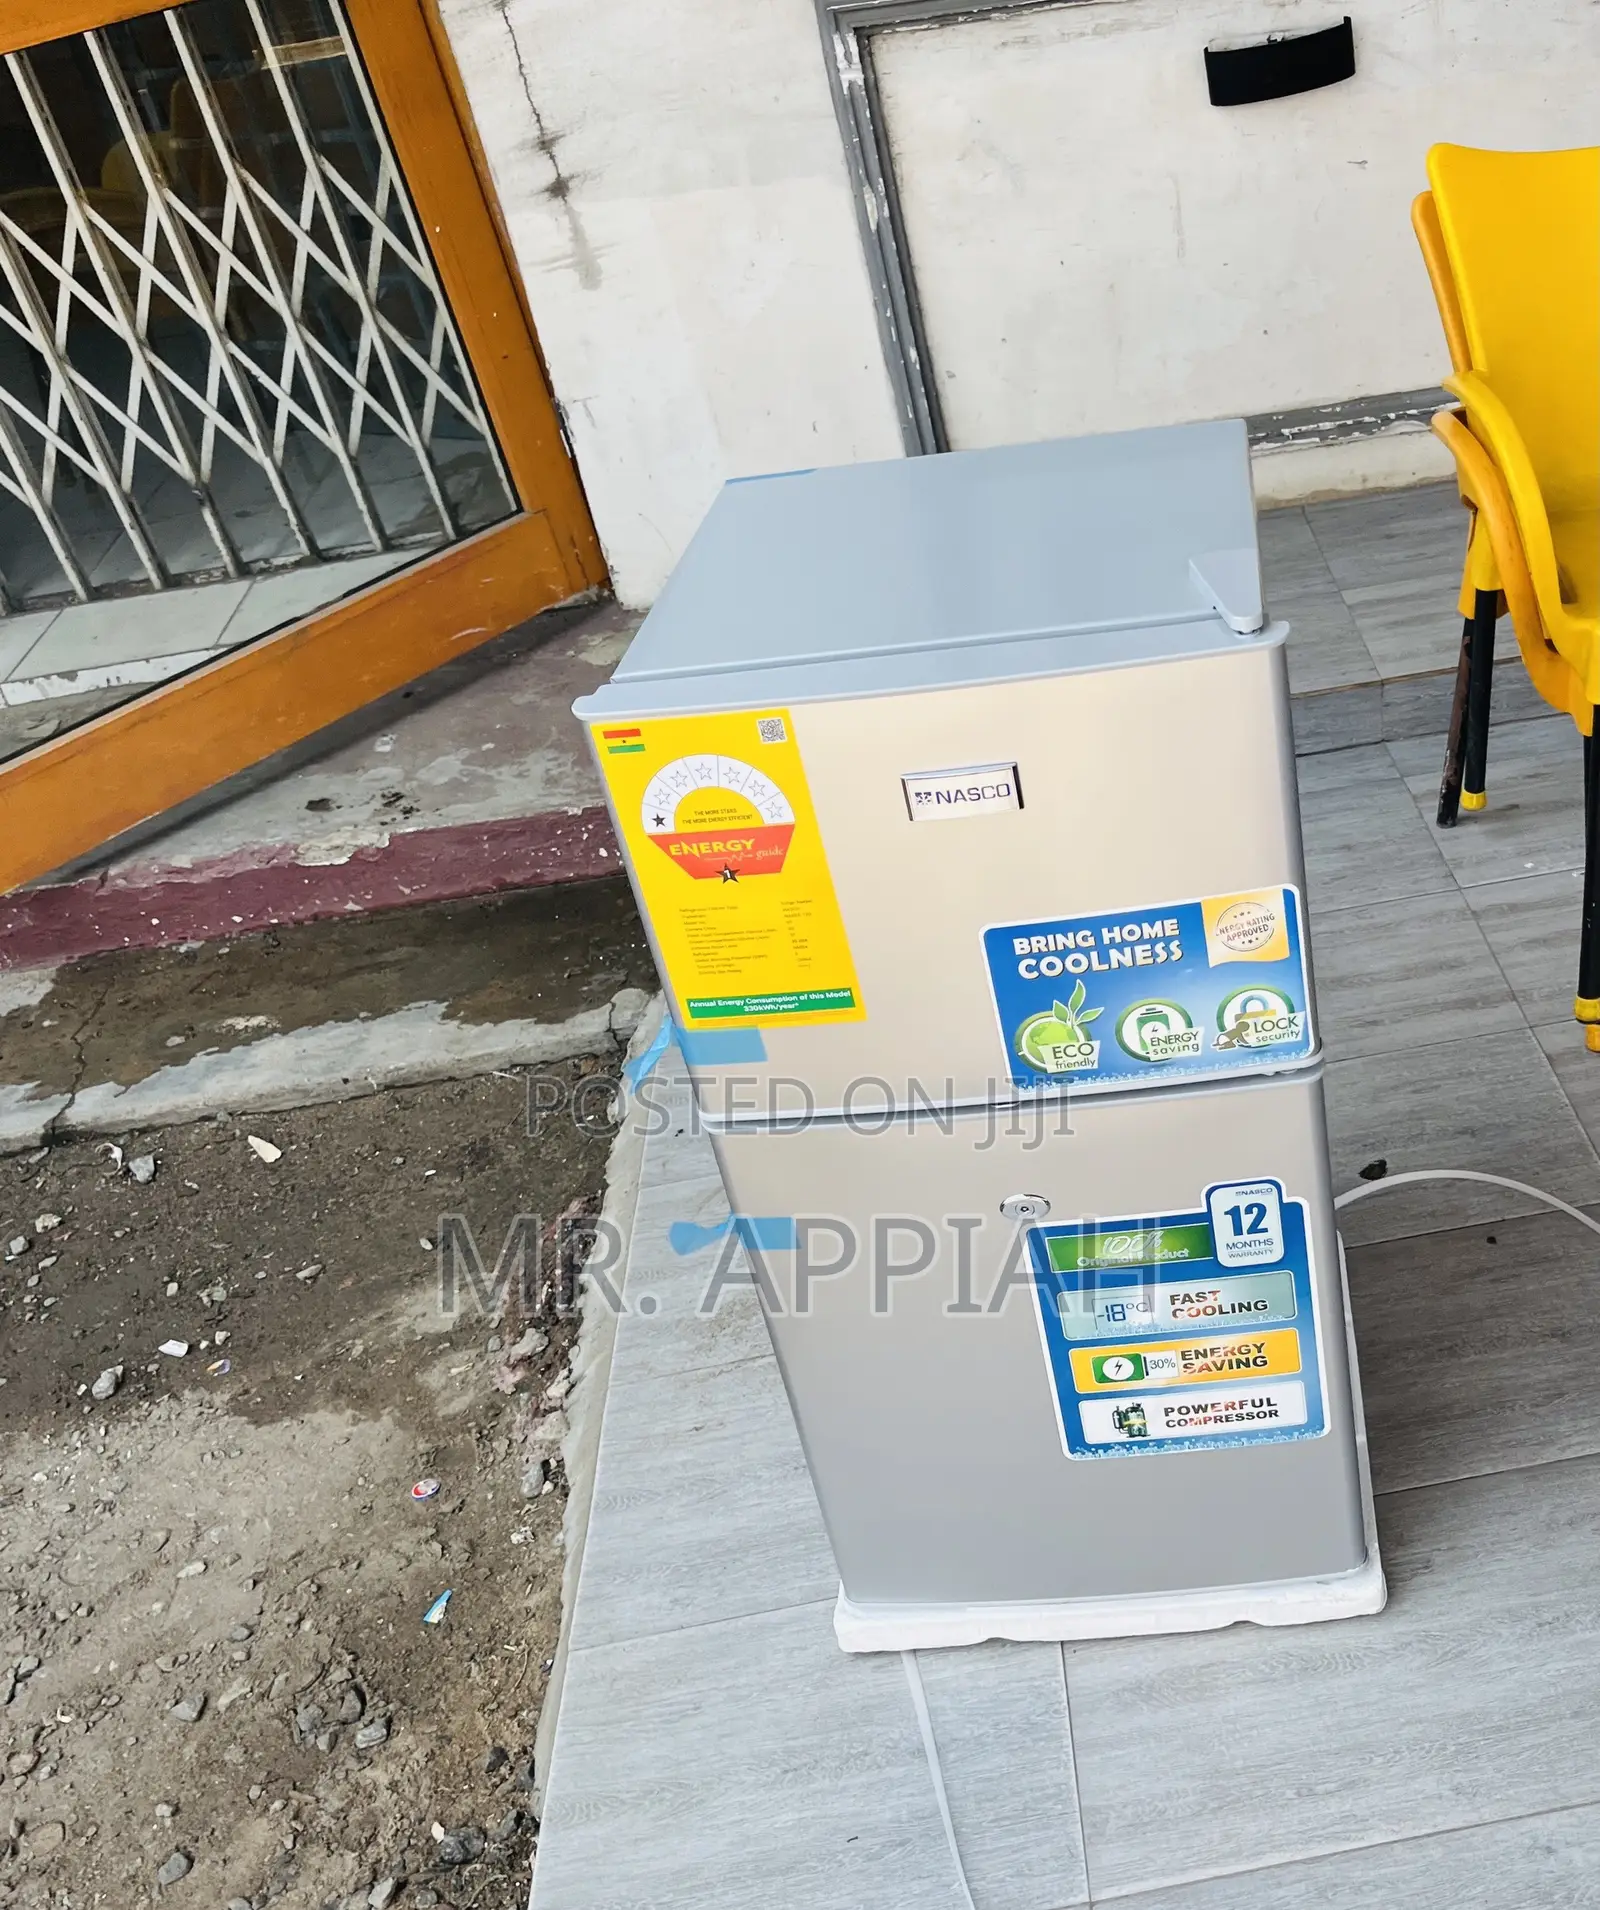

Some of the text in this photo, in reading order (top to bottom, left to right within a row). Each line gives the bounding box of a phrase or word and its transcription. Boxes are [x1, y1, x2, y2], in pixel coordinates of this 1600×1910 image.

[935, 783, 1011, 804] NASCO
[669, 838, 756, 858] ENERGY
[756, 845, 784, 860] guide
[724, 869, 731, 879] 1
[1216, 913, 1275, 937] NERGY RATING
[1226, 923, 1269, 942] APPROVED
[1012, 918, 1180, 955] BRING HOME
[1018, 939, 1184, 980] COOLNESS
[690, 999, 717, 1008] Annual
[718, 998, 745, 1007] Energy
[745, 994, 798, 1004] Consumption
[809, 992, 825, 1000] this
[826, 989, 851, 998] Model
[1253, 1015, 1299, 1034] LOCK
[1150, 1031, 1200, 1047] ENERGY
[1255, 1027, 1301, 1044] security
[1052, 1042, 1095, 1060] ECO
[1151, 1041, 1200, 1057] saving
[1055, 1057, 1097, 1071] friendly
[1240, 1187, 1273, 1196] NASCO
[1223, 1202, 1269, 1237] 12
[1226, 1238, 1274, 1250] MONTHS
[1227, 1248, 1274, 1258] WARRANTY
[1077, 1247, 1190, 1267] Original Product
[1169, 1290, 1222, 1306] FAST
[1171, 1299, 1269, 1320] COOLING
[1180, 1342, 1267, 1362] ENERGY
[1149, 1357, 1176, 1371] 30%
[1182, 1355, 1269, 1375] SAVING
[1163, 1397, 1278, 1417] POWERFUL
[1165, 1409, 1280, 1428] COMPRESSOR
